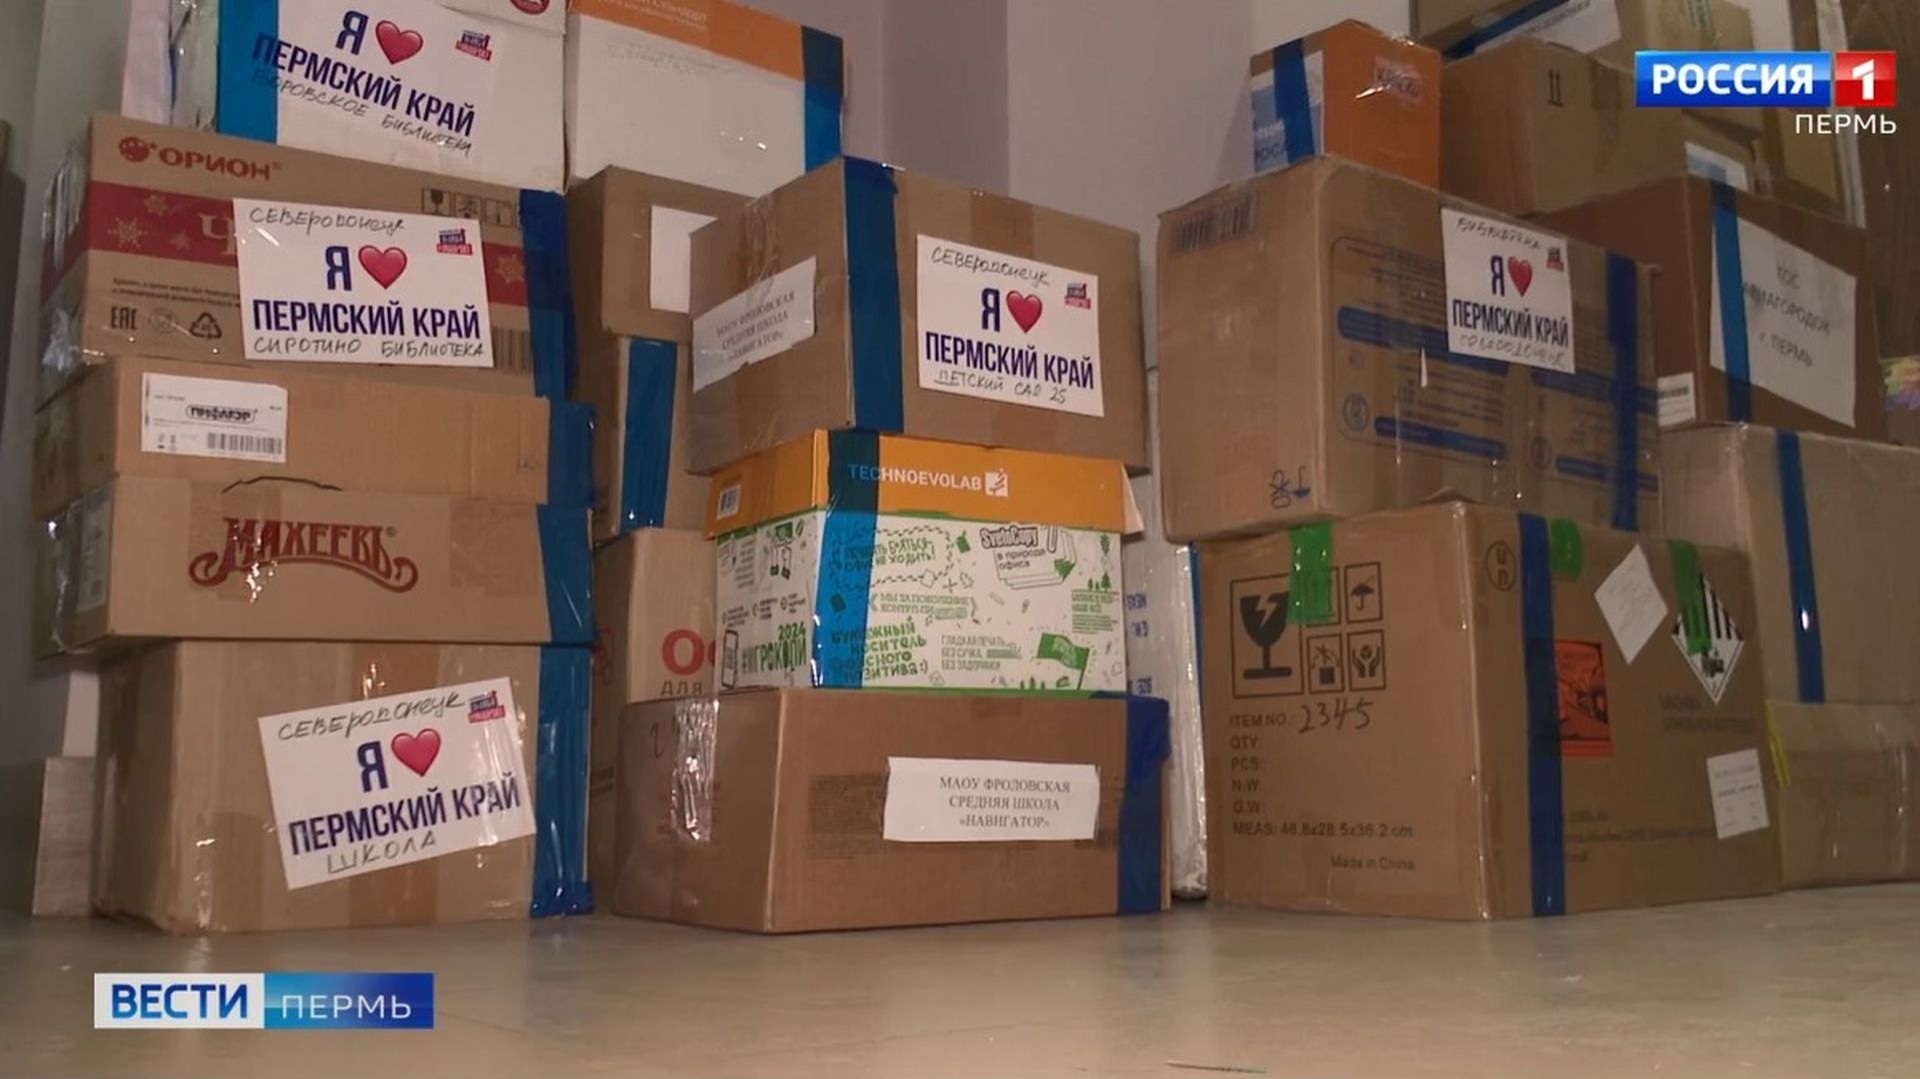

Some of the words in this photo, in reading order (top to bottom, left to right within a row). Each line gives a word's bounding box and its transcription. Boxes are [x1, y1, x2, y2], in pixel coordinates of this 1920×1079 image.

[336, 10, 369, 56] Я
[252, 32, 402, 111] ПЕРМСКИЙ
[405, 88, 476, 137] КРАЙ
[159, 146, 270, 181] ОРИОН
[325, 246, 352, 291] Я
[1490, 255, 1505, 297] Я
[252, 300, 405, 336] ПЕРМСКИЙ
[413, 304, 481, 339] КРАЙ
[981, 287, 1000, 332] Я
[1452, 299, 1533, 341] ПЕРМСКИЙ
[1535, 316, 1569, 348] КРАЙ
[254, 336, 362, 354] СИРОТИНО
[381, 340, 484, 358] БИБЛИОТЕКА
[925, 331, 1038, 380] ПЕРМСКИЙ
[1044, 353, 1094, 389] КРАЙ
[848, 463, 983, 491] TECHNOEVOLAB
[777, 622, 807, 642] 2024
[660, 680, 705, 697] ДЛЯ
[1297, 697, 1374, 734] 2345
[356, 740, 389, 793] Я
[939, 775, 980, 791] МАОУ
[983, 776, 1071, 794] ФРОЛОВСКАЯ
[288, 787, 447, 856] ПЕРМСКИЙ
[451, 771, 521, 820] КРАЙ
[948, 795, 1010, 811] СРЕДНЯЯ
[1012, 797, 1061, 812] ШКОЛА
[959, 814, 1051, 829] «НАВИГАТОР»
[326, 829, 437, 874] ШКОЛА
[1330, 856, 1363, 870] Made
[1379, 856, 1416, 871] China
